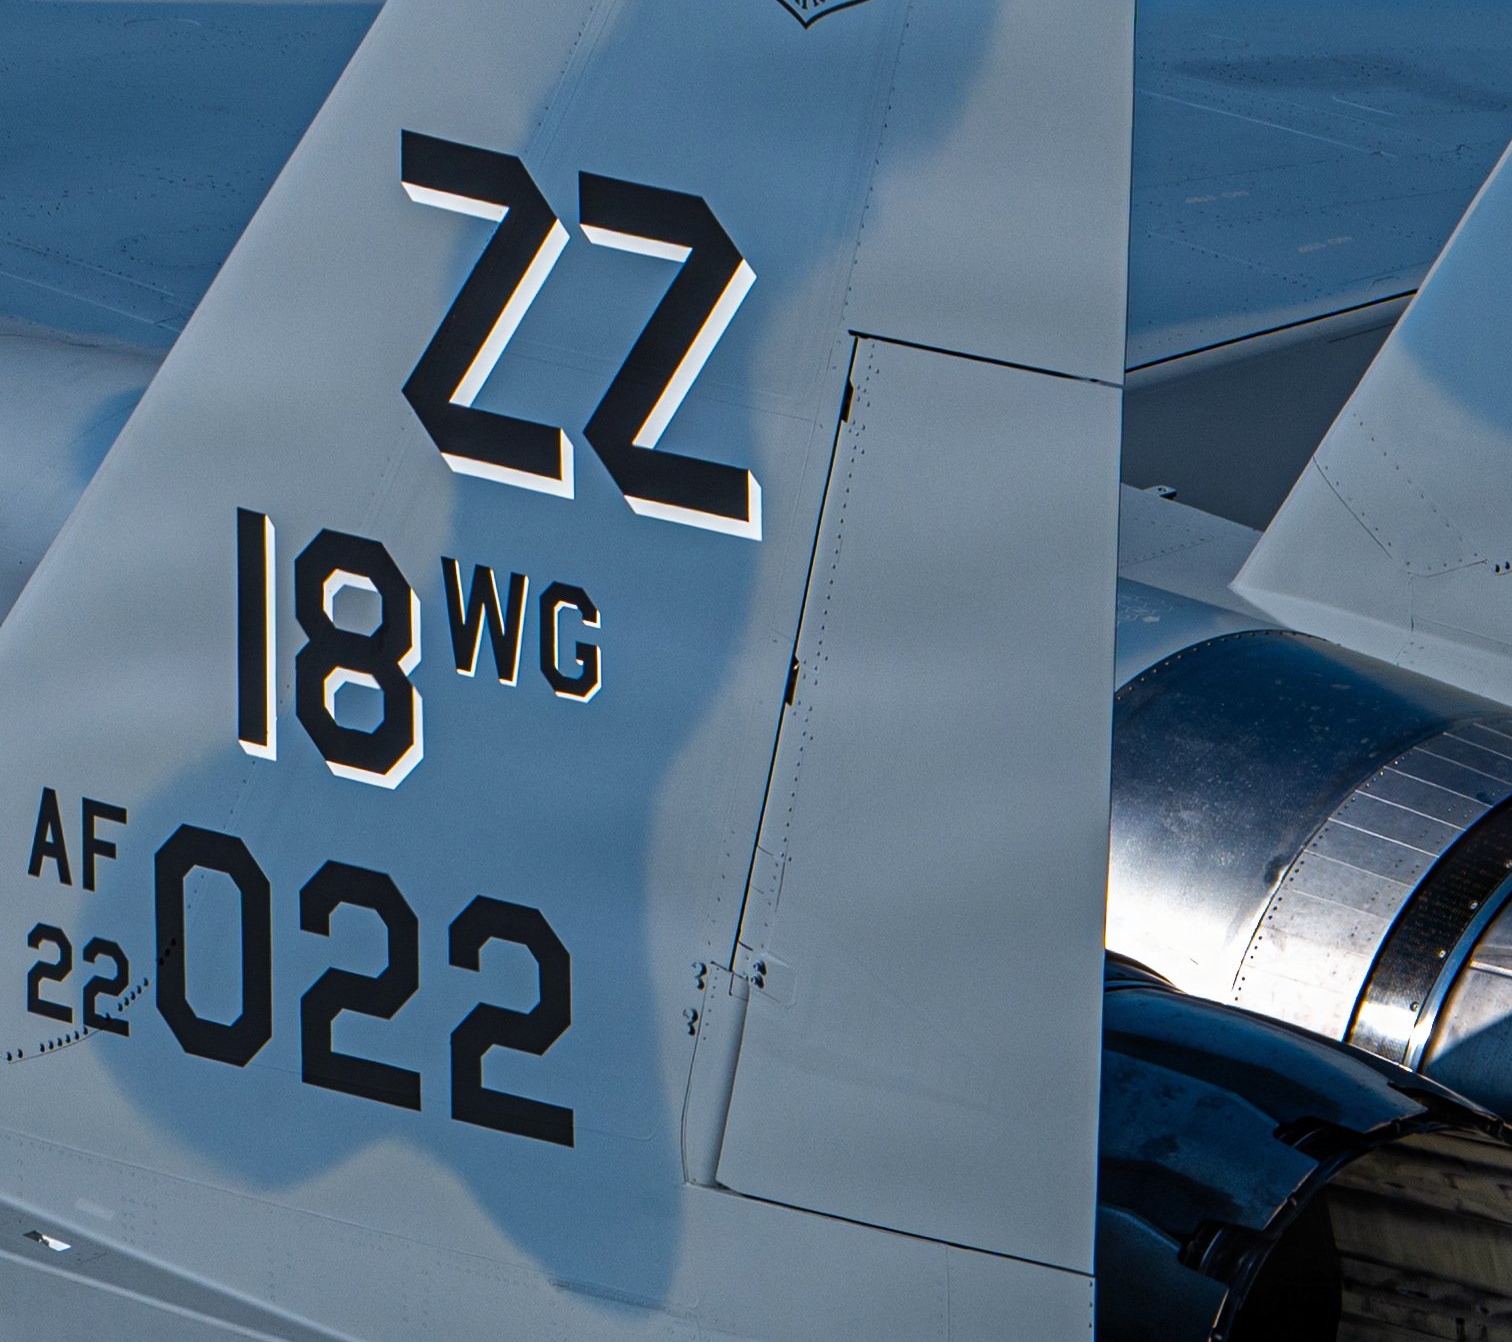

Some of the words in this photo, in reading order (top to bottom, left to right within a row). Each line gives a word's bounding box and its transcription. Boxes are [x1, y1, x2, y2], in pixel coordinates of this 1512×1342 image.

[400, 128, 763, 542] ZZ
[237, 506, 424, 790] 18
[441, 556, 603, 704] WG
[26, 921, 129, 1037] 22
[27, 786, 128, 892] AF
[153, 822, 576, 1148] 022
